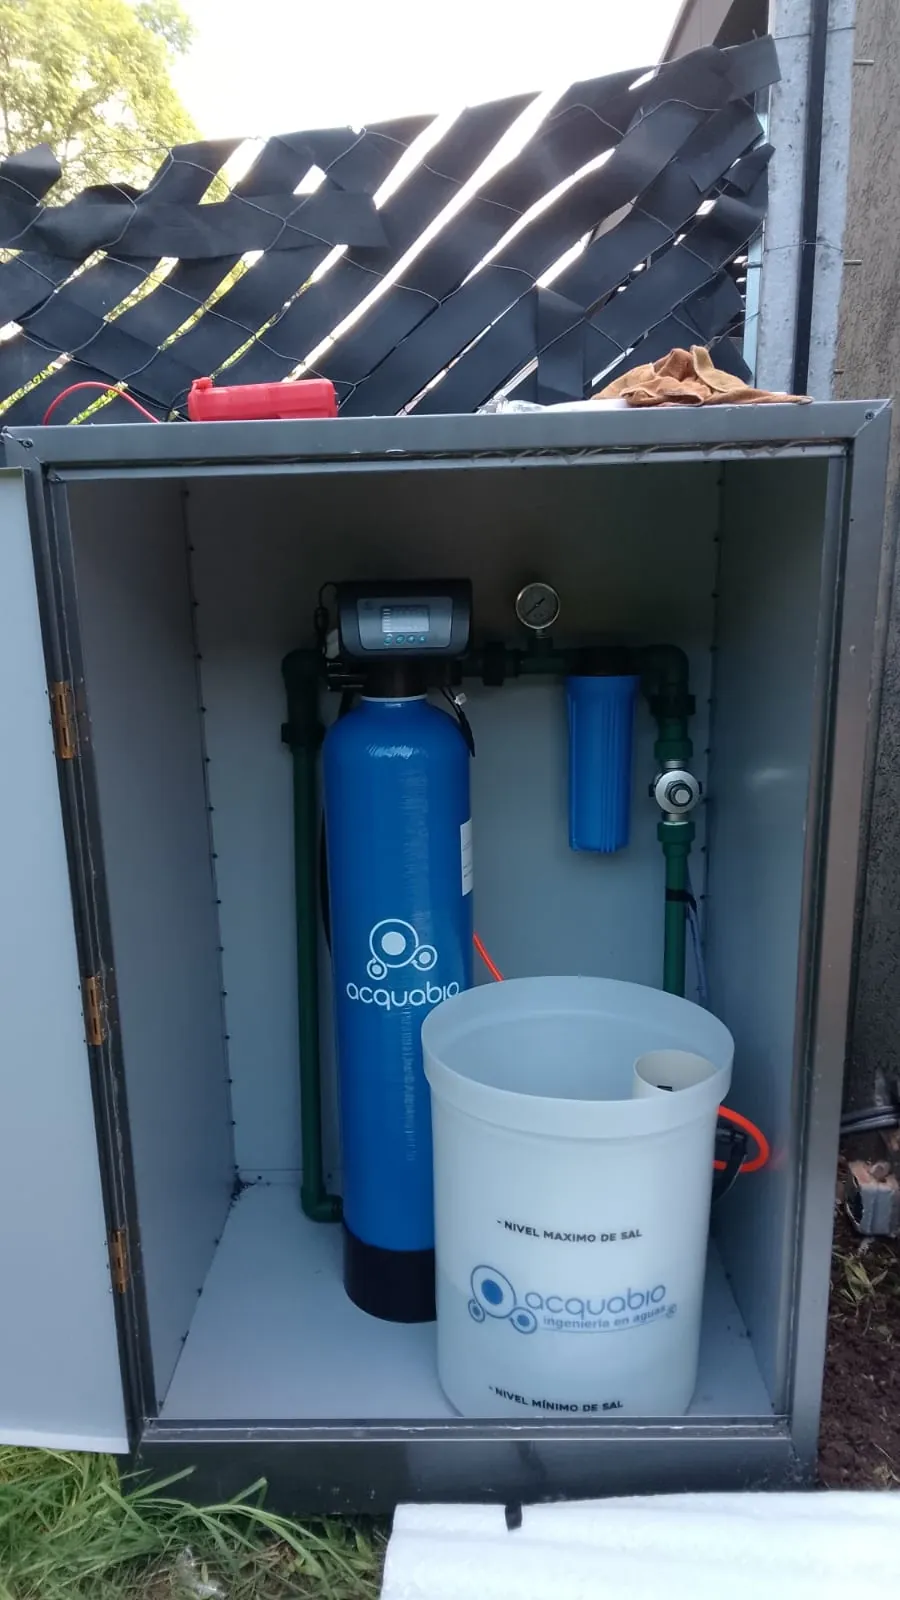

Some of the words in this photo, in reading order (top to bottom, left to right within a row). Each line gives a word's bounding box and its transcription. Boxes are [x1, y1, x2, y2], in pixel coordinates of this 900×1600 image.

[346, 981, 460, 1011] acquabio
[504, 1220, 540, 1237] NIVEL
[600, 1232, 617, 1242] DE
[621, 1229, 643, 1240] SAL
[525, 1284, 667, 1320] acquabio
[614, 1316, 630, 1326] en
[495, 1387, 528, 1405] NIVEL
[531, 1399, 578, 1412] MÍNIMO
[582, 1404, 598, 1412] DE
[602, 1400, 624, 1411] SAL
